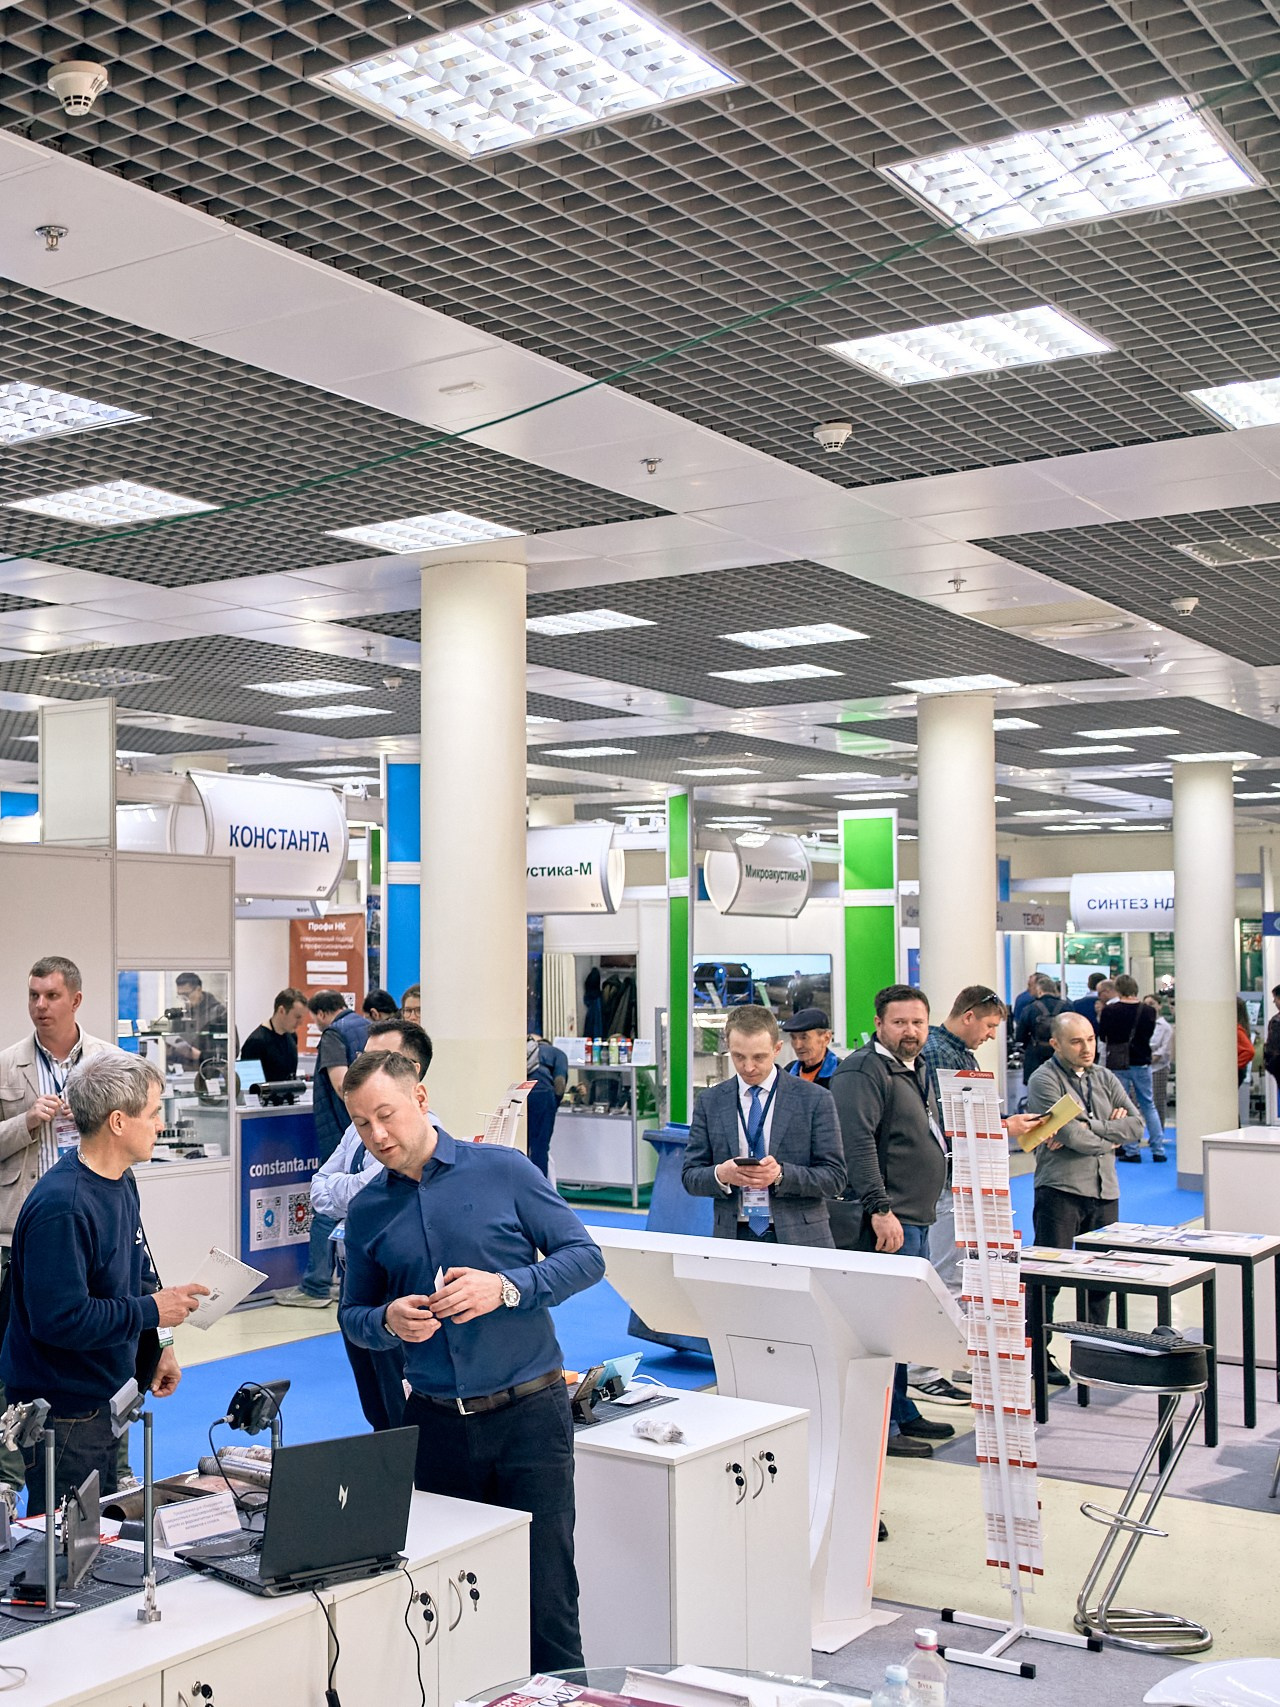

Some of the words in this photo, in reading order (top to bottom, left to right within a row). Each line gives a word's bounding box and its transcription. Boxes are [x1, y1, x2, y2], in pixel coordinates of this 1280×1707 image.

[229, 824, 330, 853] КОНСТАНТА
[527, 862, 592, 878] стика-М
[746, 864, 806, 883] Микроакустика-М
[1087, 898, 1148, 910] СИНТЕЗ
[1155, 898, 1174, 910] НД
[308, 922, 333, 931] Профи
[335, 922, 346, 931] НК
[250, 1158, 318, 1177] constanta.ru
